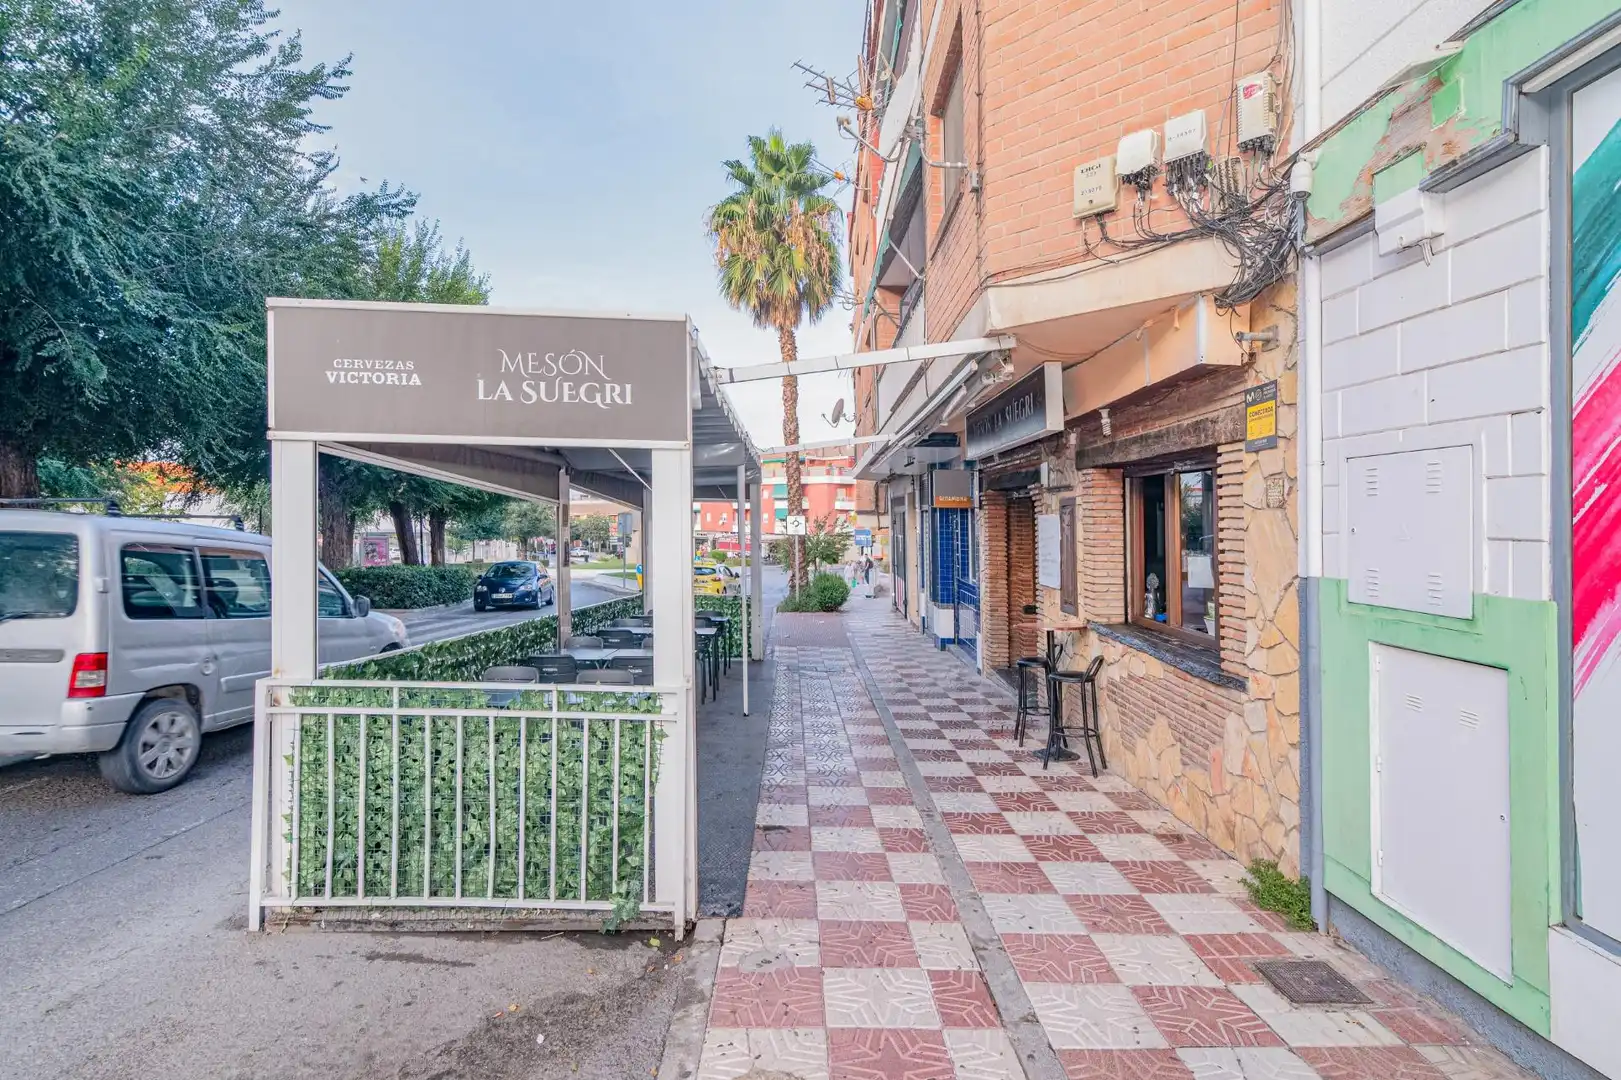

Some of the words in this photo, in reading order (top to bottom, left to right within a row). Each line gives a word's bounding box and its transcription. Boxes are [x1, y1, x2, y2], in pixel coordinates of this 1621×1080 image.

[333, 358, 415, 371] CERVEZAS
[497, 348, 611, 381] MESÓN
[325, 370, 422, 386] VICTORIA
[477, 379, 514, 401] LA
[520, 377, 632, 409] SUEGRI
